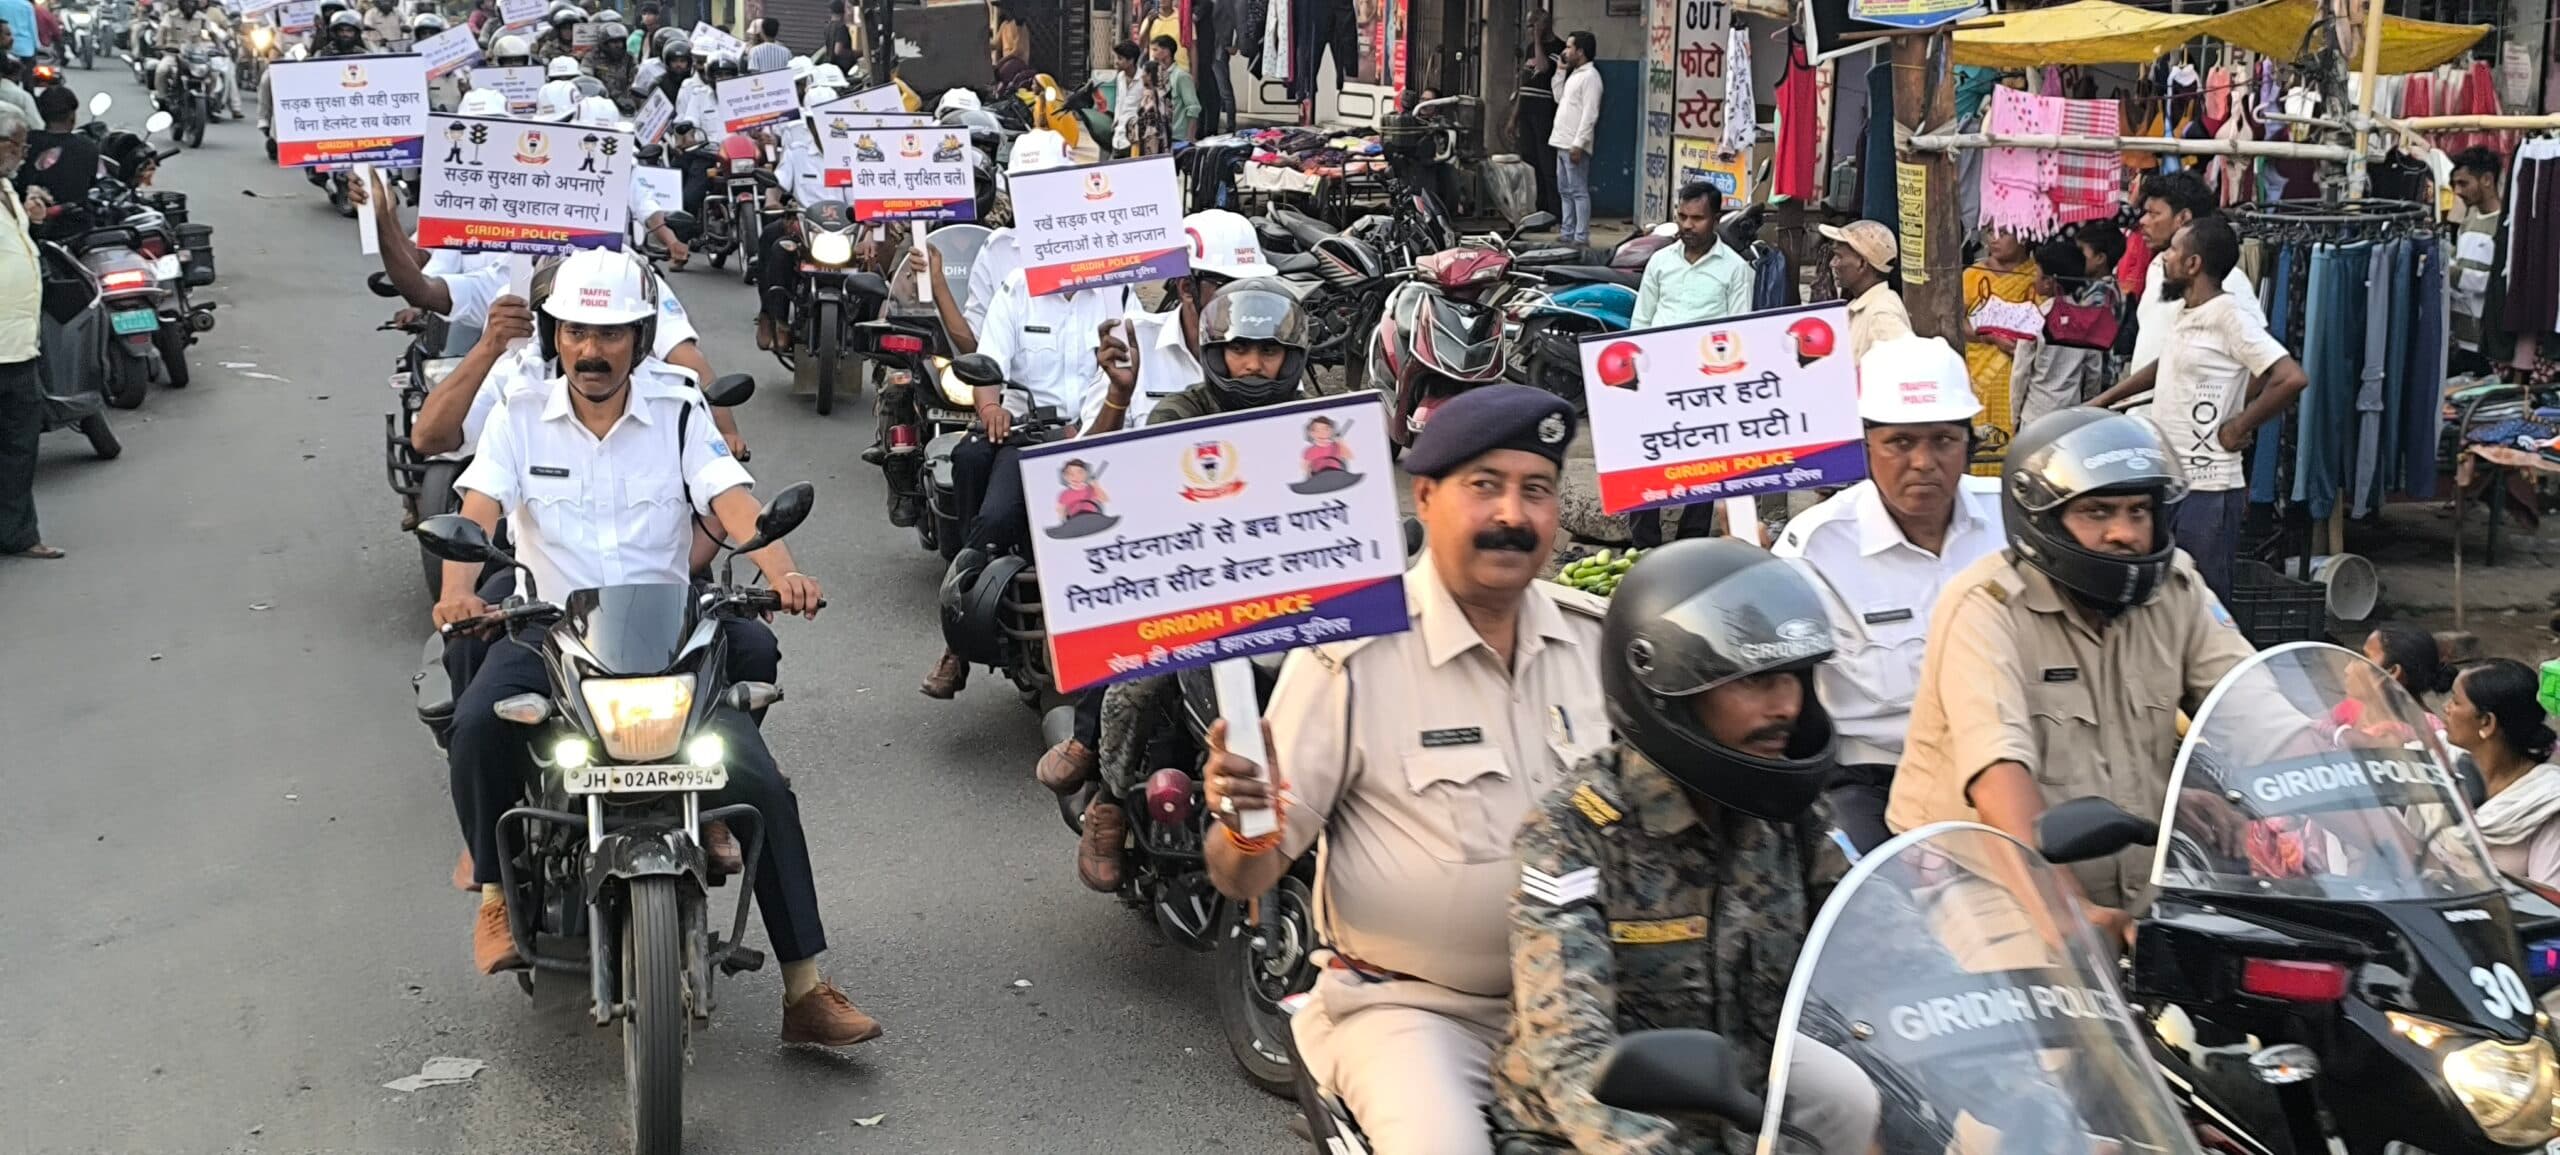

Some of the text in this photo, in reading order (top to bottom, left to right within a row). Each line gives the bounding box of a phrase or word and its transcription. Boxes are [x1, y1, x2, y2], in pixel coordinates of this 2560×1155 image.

[1687, 1, 1725, 30] OUT
[1680, 42, 1724, 78] फोटो
[280, 90, 420, 113] सड़क सुरक्षा की यही पुकार
[1679, 90, 1724, 129] स्टेट
[294, 117, 318, 132] बिना
[323, 115, 357, 131] हेलमेट
[316, 138, 393, 150] GIRIDIH POLICE
[444, 167, 483, 187] सड़क
[487, 170, 527, 189] सुरक्षा
[532, 170, 551, 189] को
[857, 169, 875, 188] धीरे
[904, 168, 941, 191] सुरक्षित
[434, 190, 474, 211] जीवन
[479, 194, 497, 212] को
[502, 199, 558, 217] खुशहाल
[883, 199, 943, 208] GIRIDIH POLICE
[1033, 203, 1159, 232] रखें सड़क पर पूरा ध्यान
[443, 236, 463, 247] सेवा
[467, 237, 478, 248] ही
[465, 224, 569, 242] GIRIDIH POLICE
[1034, 227, 1167, 261] दुर्घटनाओं से हो अनजान
[1235, 247, 1256, 255] TRAFFIC
[1237, 256, 1255, 264] POLICE
[1070, 255, 1142, 273] GIRIDIH POLICE
[1136, 265, 1157, 279] पुलिस
[579, 288, 611, 296] TRAFFIC
[580, 299, 608, 307] POLICE
[1666, 371, 1782, 411] नजर हटी
[1899, 381, 1938, 391] TRAFFIC
[1903, 394, 1937, 404] POLICE
[1641, 422, 1730, 460] दुर्घटना
[1738, 408, 1790, 439] घटी
[1664, 451, 1796, 480] GIRIDIH POLICE
[1783, 468, 1823, 488] पुलिस
[1084, 499, 1350, 573] दुर्घटनाओं से बच पाएंगे
[1065, 577, 1160, 613] नियमित
[1164, 563, 1215, 593] सीट
[1221, 557, 1274, 583] बेल्ट
[1280, 536, 1364, 571] लगाएंगे
[1137, 594, 1314, 640] GIRIDIH POLICE
[1296, 616, 1352, 645] पुलिस
[583, 769, 714, 788] JH 02AR 9954
[2254, 758, 2448, 801] GIRIDIH POLICE
[2469, 962, 2534, 1020] 30
[1889, 984, 2124, 1041] GIRIDIH POLICE
